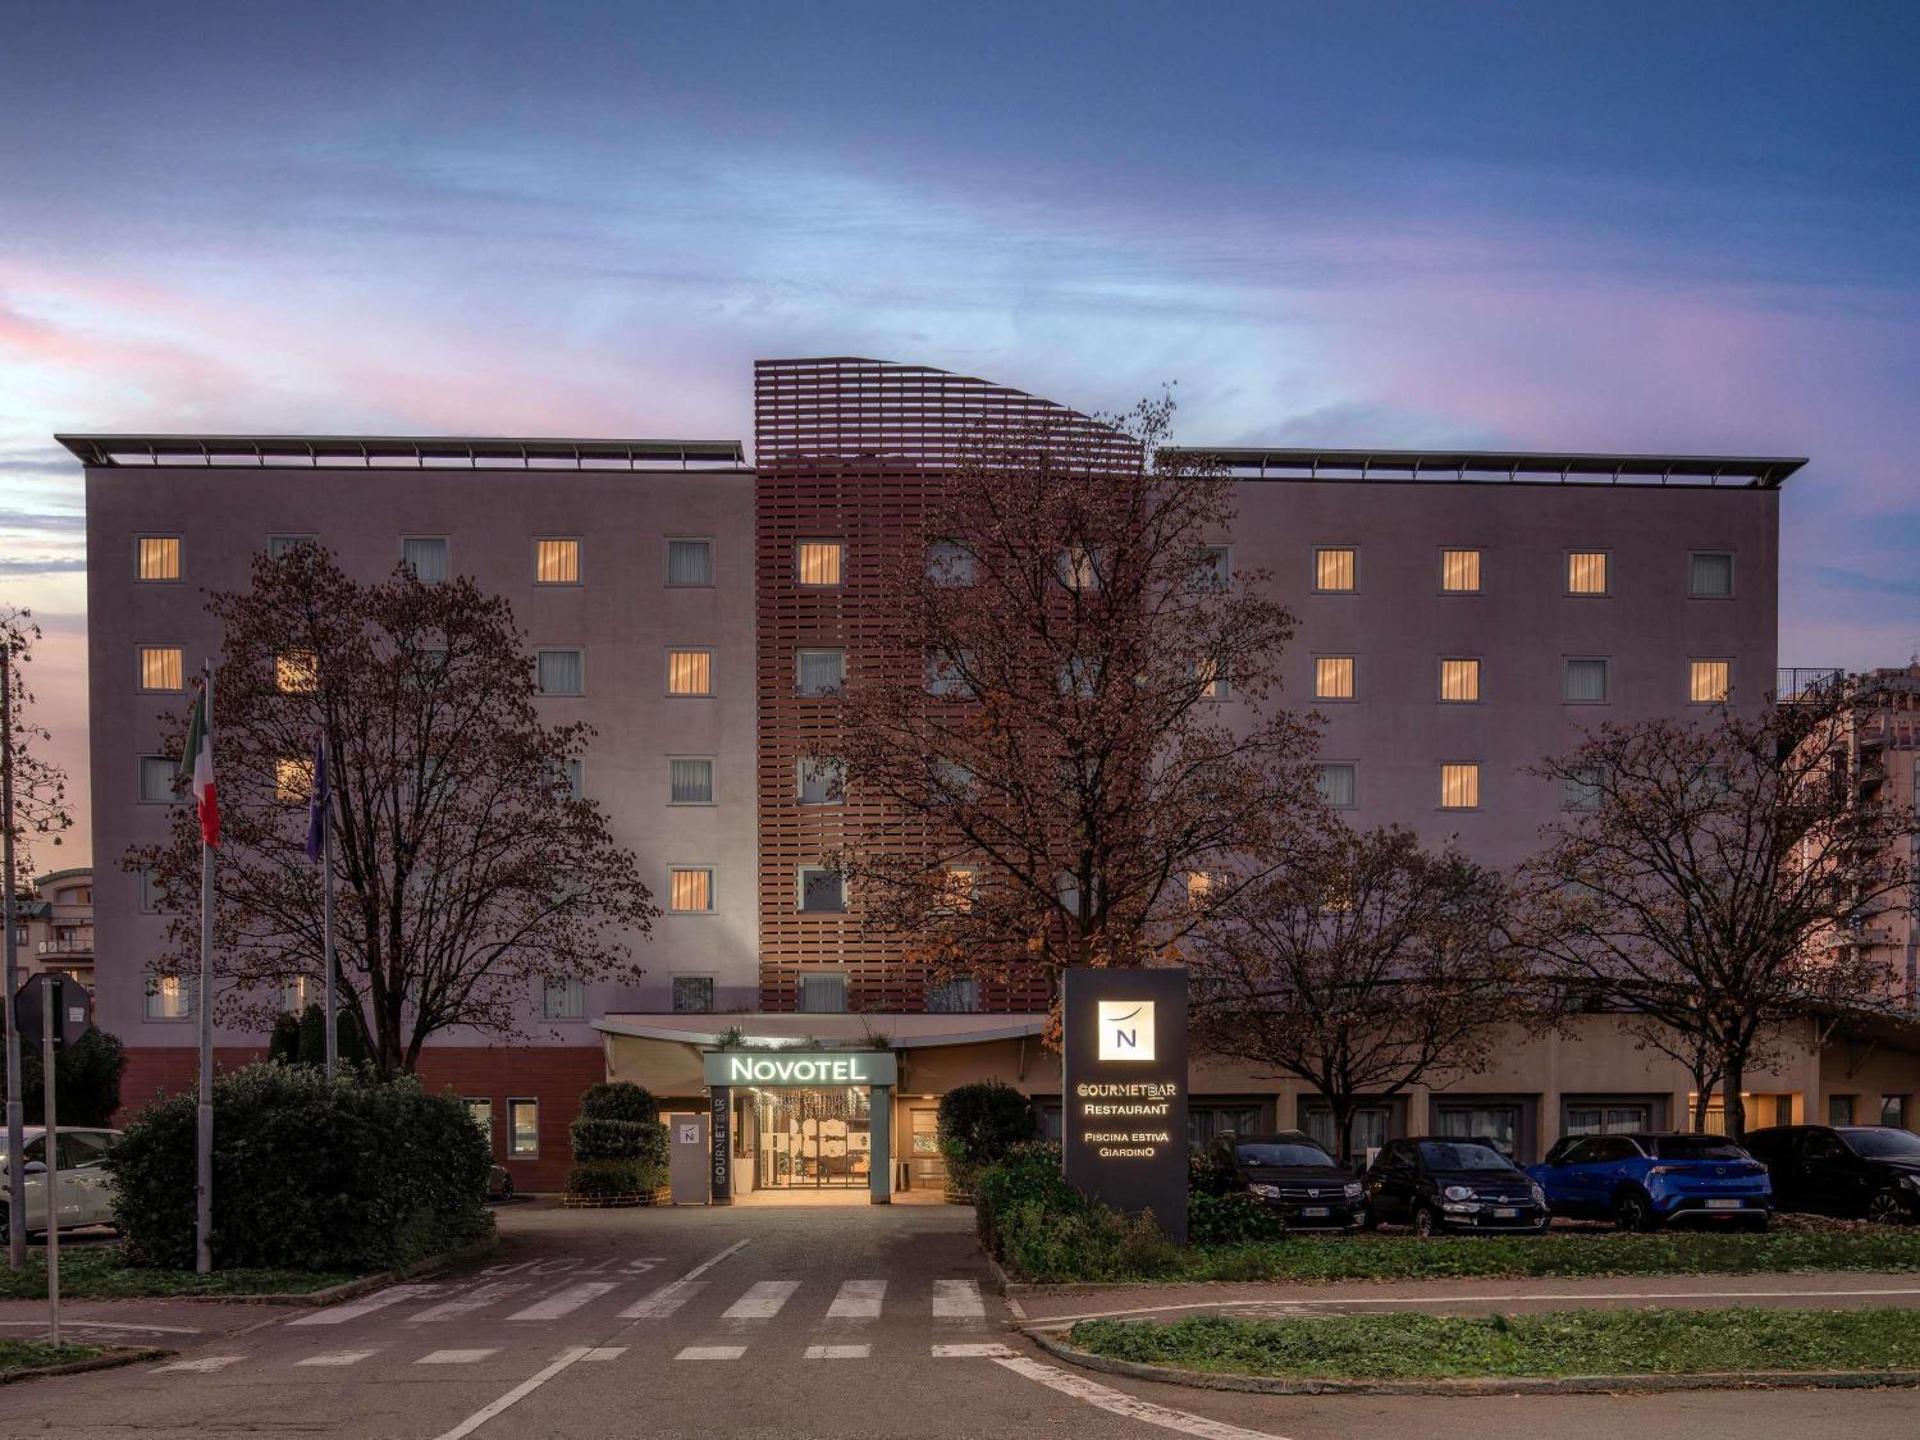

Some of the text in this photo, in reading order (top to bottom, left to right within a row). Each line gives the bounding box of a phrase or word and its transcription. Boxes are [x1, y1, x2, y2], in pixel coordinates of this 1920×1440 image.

[1116, 1028, 1137, 1049] N
[730, 1057, 868, 1081] NOVOTEL
[1084, 1104, 1169, 1115] RESTAURANT
[1084, 1132, 1169, 1142] PISCINA ESTIVA
[1100, 1147, 1155, 1157] GIARDINO
